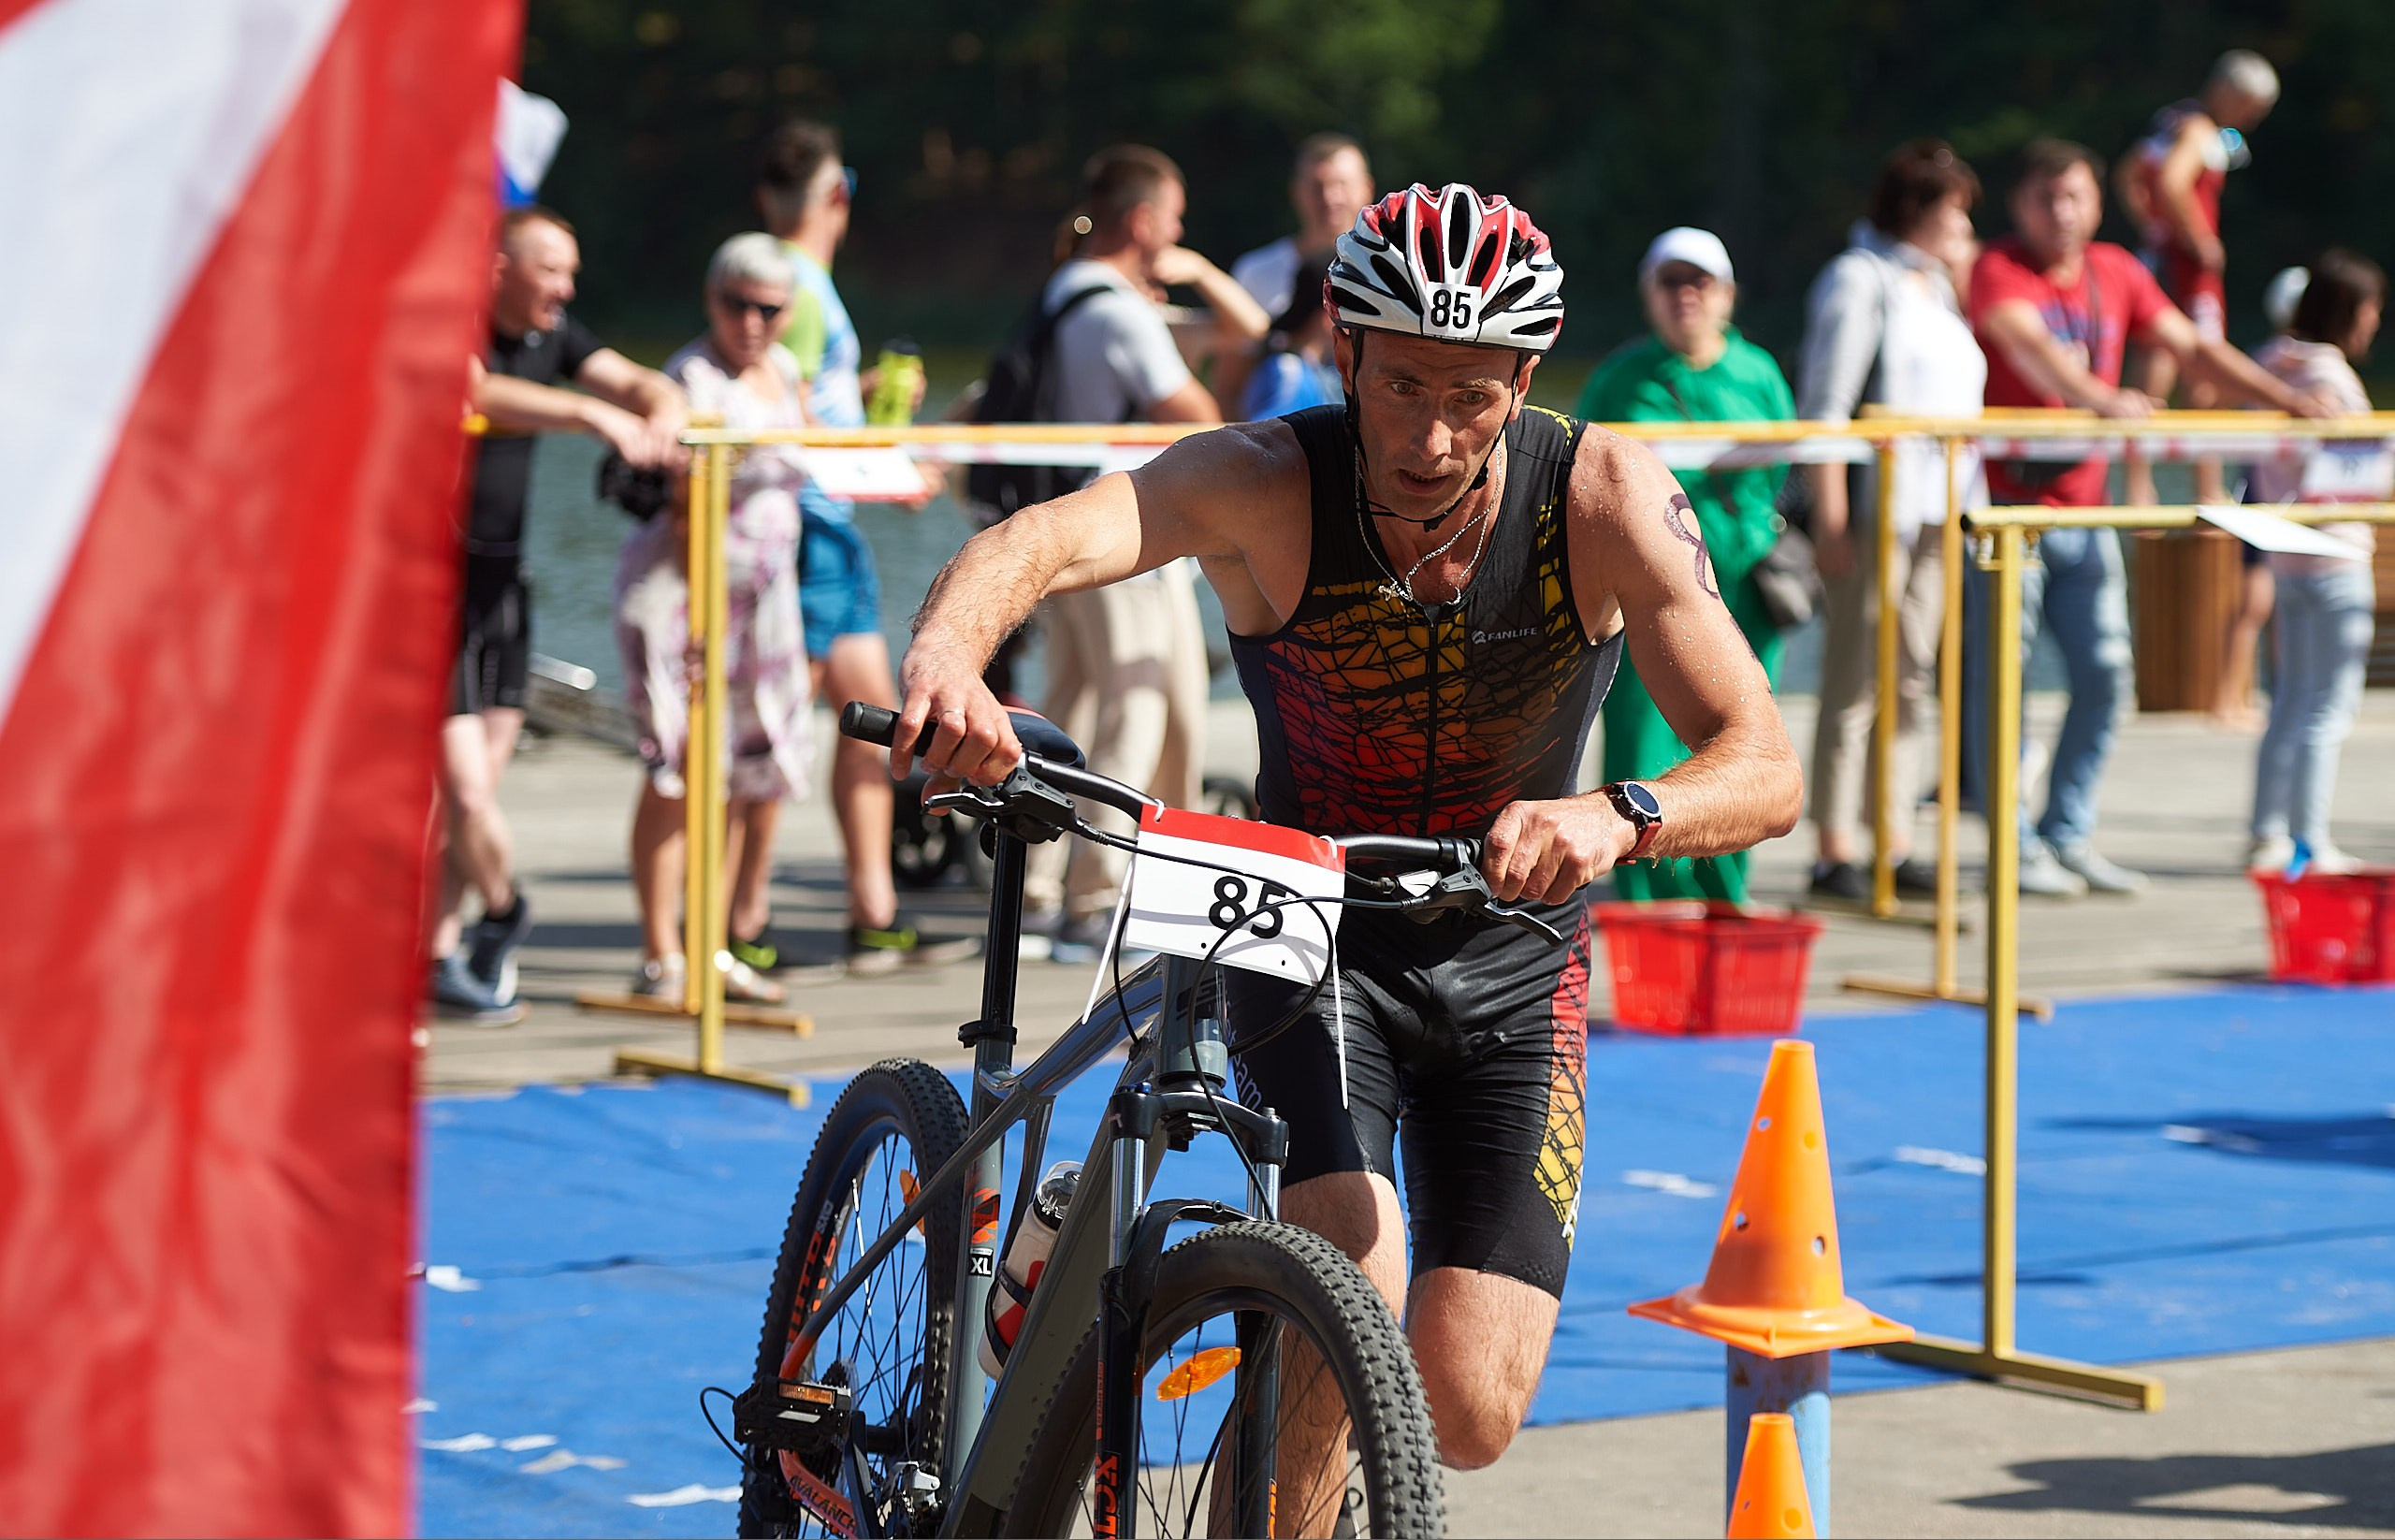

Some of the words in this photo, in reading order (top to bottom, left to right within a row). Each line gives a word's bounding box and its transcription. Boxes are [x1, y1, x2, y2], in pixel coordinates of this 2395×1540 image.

[1430, 288, 1472, 329] 85
[1488, 627, 1538, 641] FANLIFE
[1208, 875, 1287, 939] 85
[970, 1257, 992, 1275] XL
[790, 1475, 857, 1533] AVALANCH
